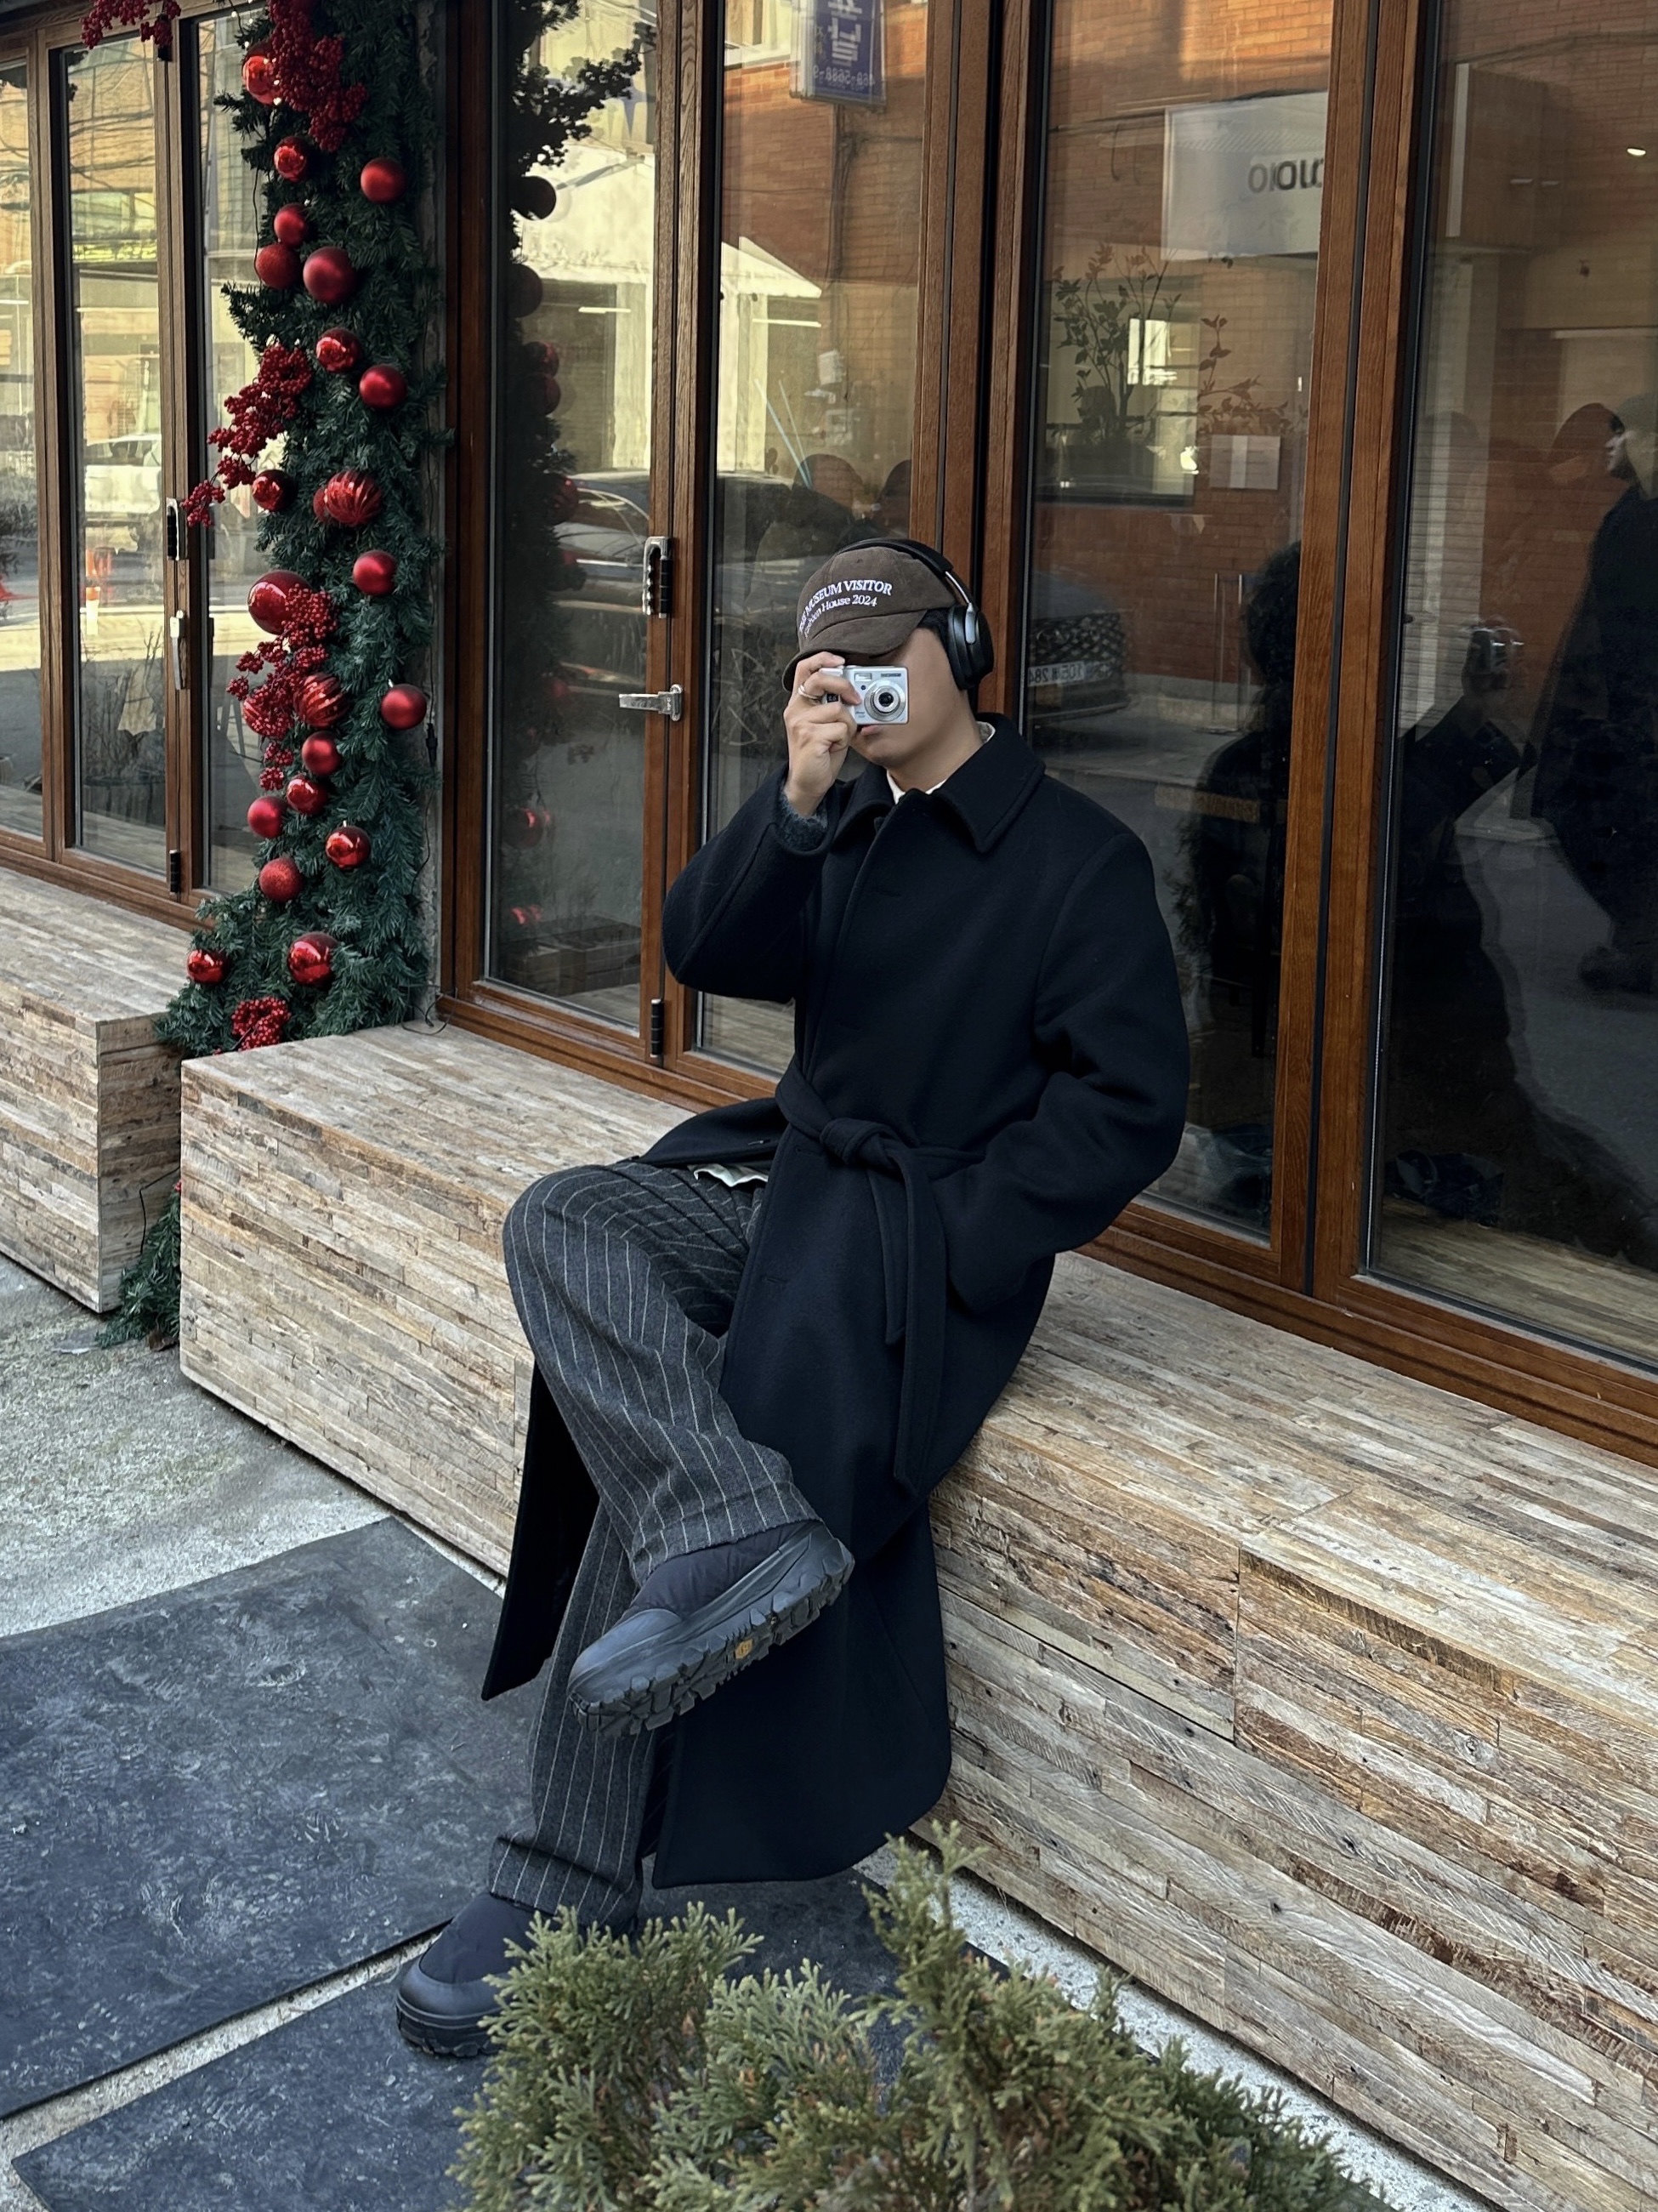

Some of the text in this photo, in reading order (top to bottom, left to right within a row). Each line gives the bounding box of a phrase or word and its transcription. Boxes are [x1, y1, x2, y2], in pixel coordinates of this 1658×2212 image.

[805, 582, 843, 616] MUSEUM
[843, 579, 893, 595] VISITOR
[821, 597, 851, 611] House
[852, 594, 877, 606] 2024
